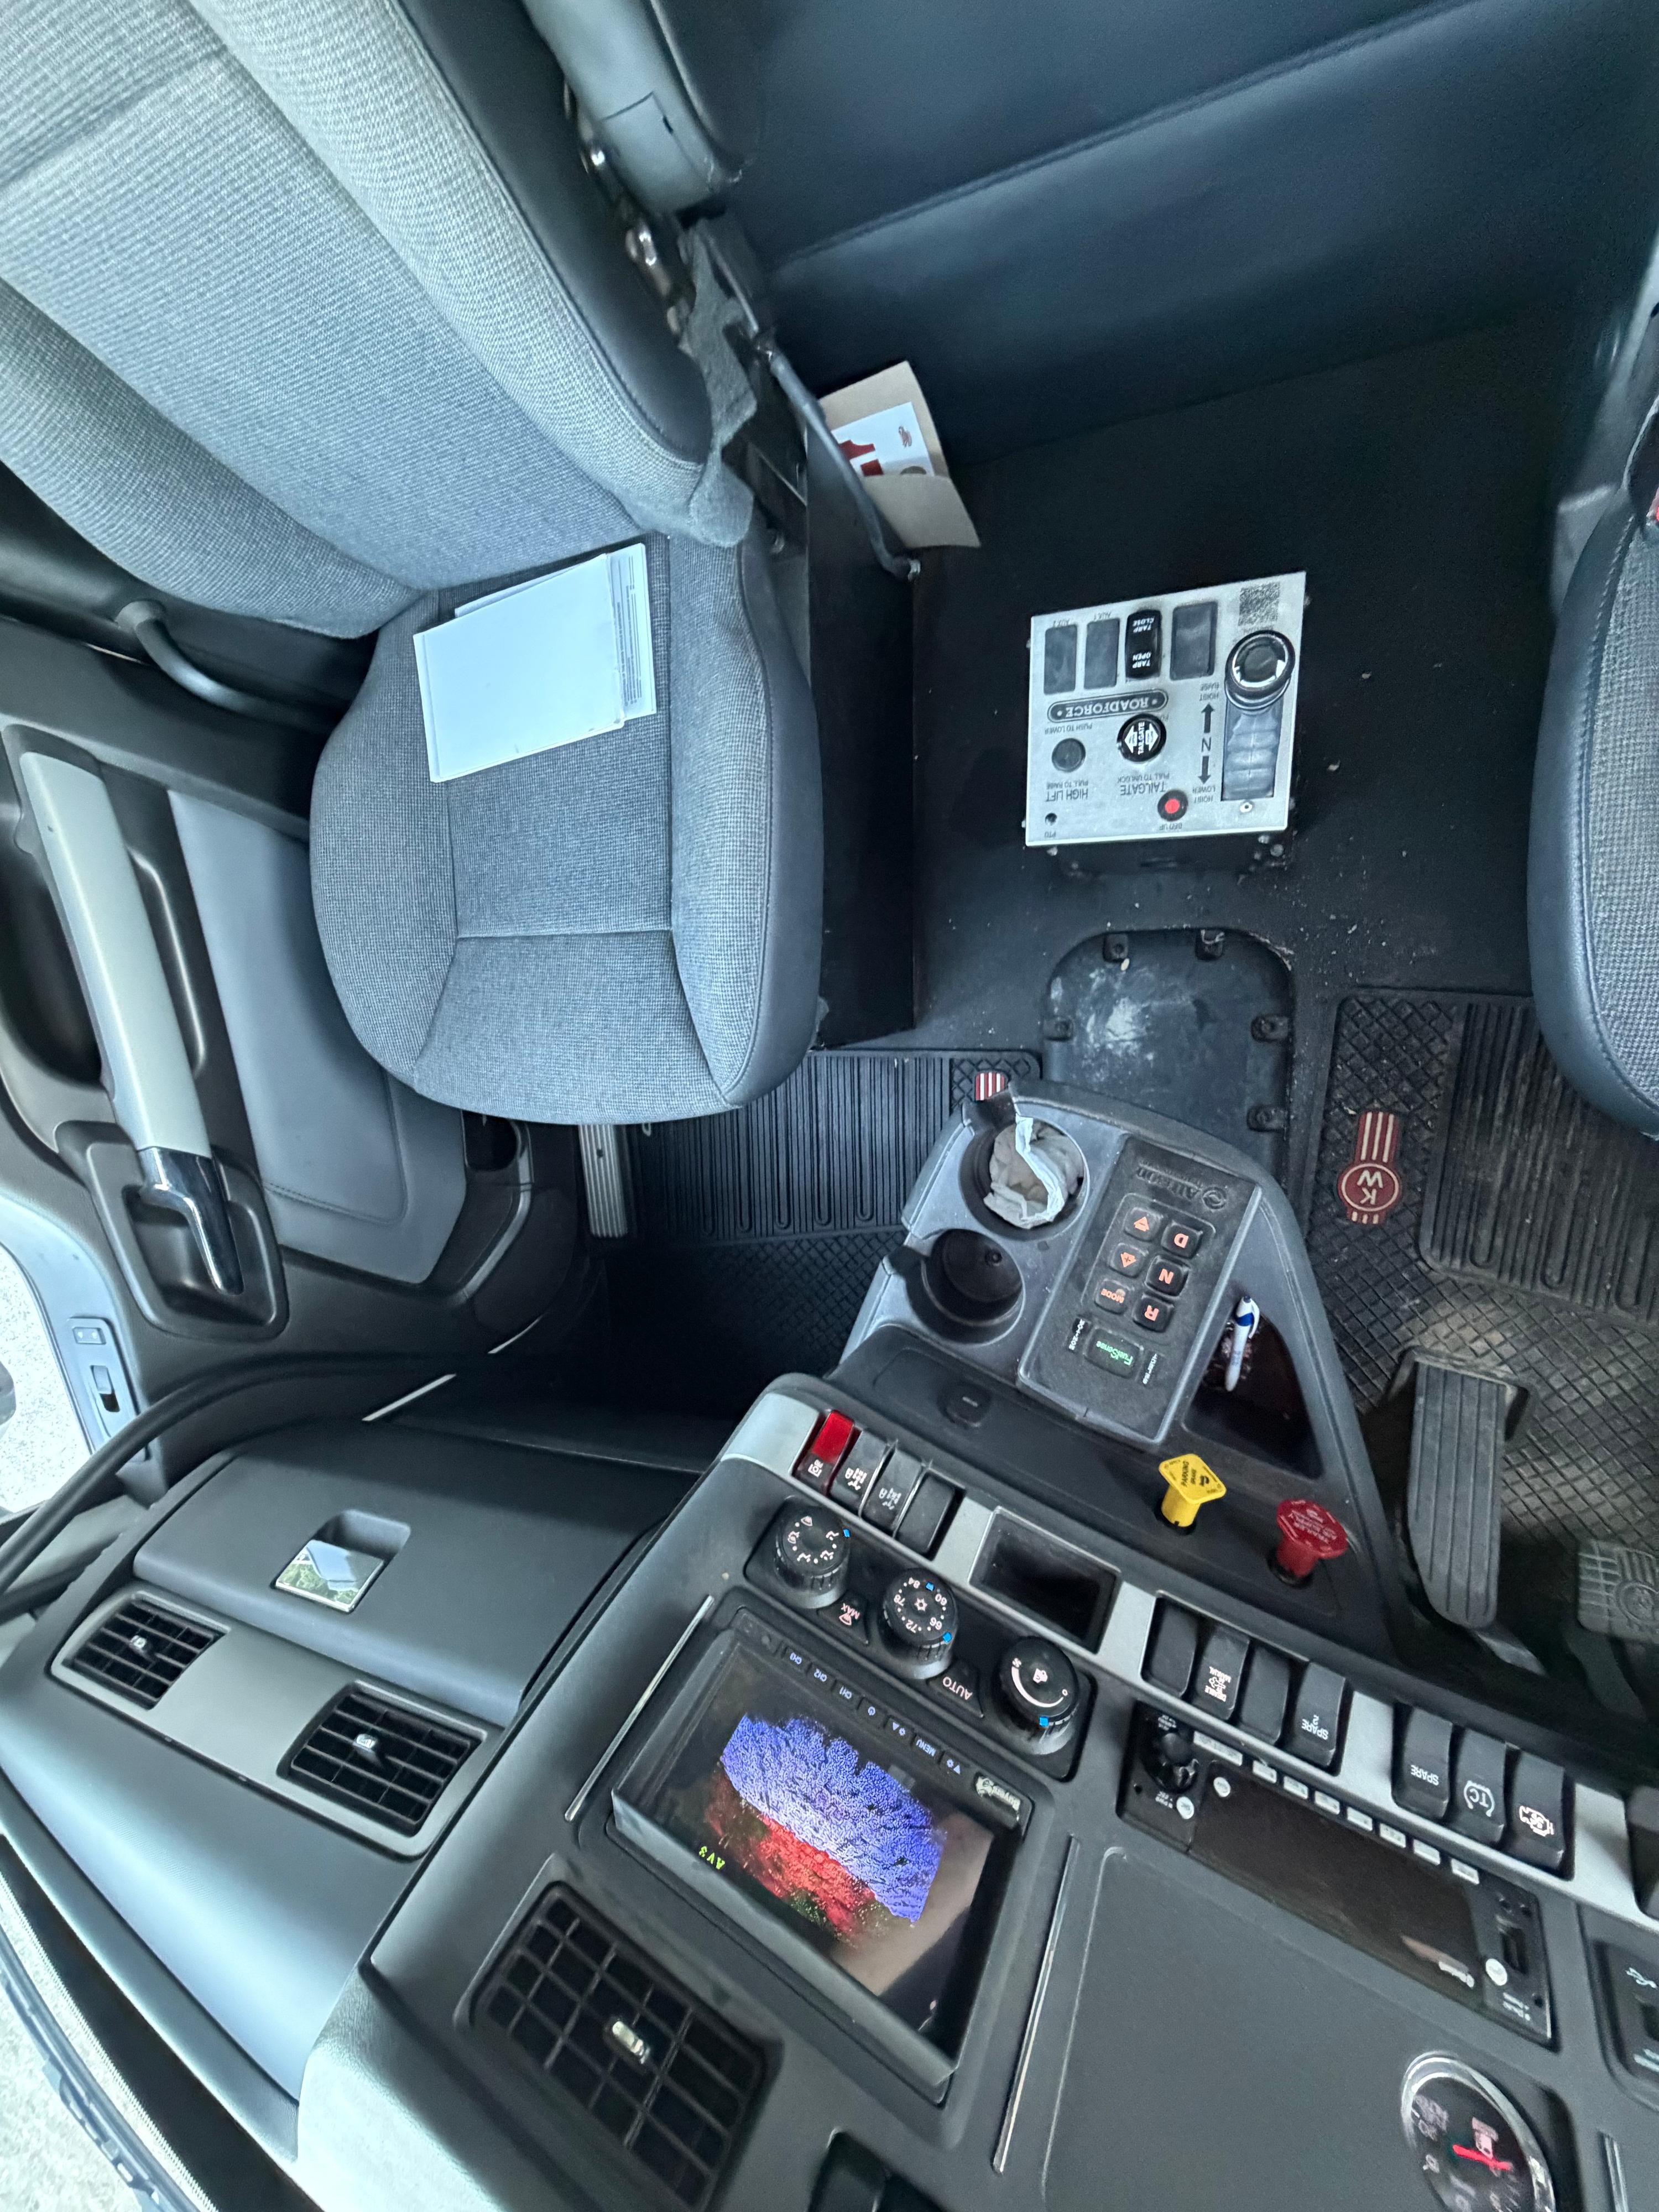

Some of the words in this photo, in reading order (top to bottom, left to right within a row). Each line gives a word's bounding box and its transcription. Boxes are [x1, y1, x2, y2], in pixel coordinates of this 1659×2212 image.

[1132, 617, 1155, 627] CLOSE
[1133, 624, 1152, 633] TARP
[1132, 651, 1152, 661] OPEN
[1132, 659, 1151, 669] TARP
[1065, 696, 1150, 718] ROADFORCE
[1044, 726, 1065, 735] LOWER
[1066, 724, 1075, 733] TO
[1076, 723, 1093, 732] PUSH
[1201, 737, 1212, 752] N
[1117, 774, 1143, 784] UNLOCK
[1045, 790, 1064, 802] LIFT
[1066, 788, 1089, 801] HIGH
[1119, 781, 1166, 796] TAILGATE
[1192, 785, 1216, 794] LOWER
[1357, 1170, 1384, 1189] W
[1360, 1187, 1376, 1205] K
[1173, 1233, 1189, 1249] D
[1158, 1268, 1174, 1285] N
[1100, 1288, 1125, 1304] MODE
[1144, 1305, 1159, 1322] R
[1095, 1340, 1133, 1366] FuelSense
[1180, 1460, 1189, 1488] PARKING
[908, 1577, 921, 1589] 84
[893, 1594, 905, 1606] 78
[935, 1593, 947, 1606] 60
[841, 1603, 860, 1620] MAX
[905, 1619, 918, 1634] 72
[929, 1616, 942, 1630] 66
[813, 1668, 827, 1682] CH2
[839, 1686, 852, 1699] CH1
[942, 1676, 973, 1700] AUTO
[1313, 1714, 1319, 1725] 2
[1301, 1719, 1328, 1740] SPARE
[915, 1739, 937, 1757] MENU
[1411, 1765, 1439, 1786] SPARE
[1469, 1788, 1489, 1808] TC
[698, 1846, 726, 1870] AV3
